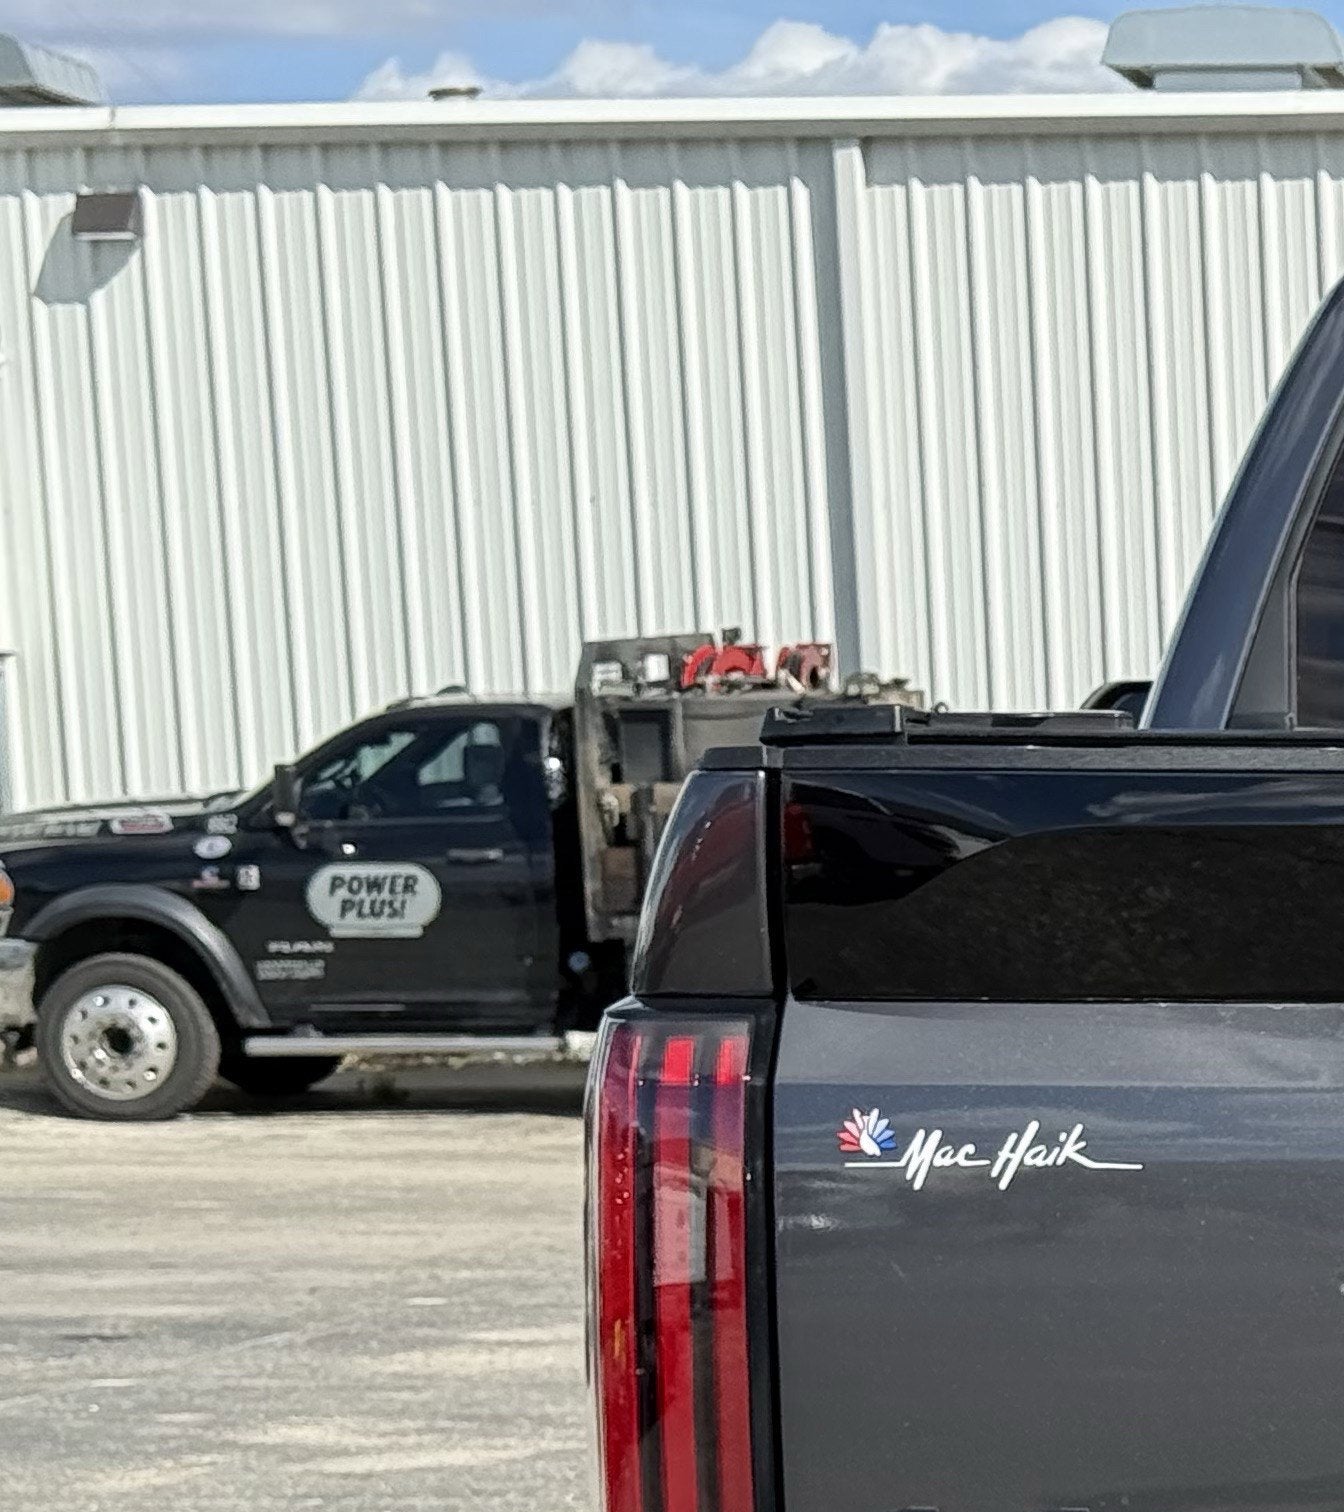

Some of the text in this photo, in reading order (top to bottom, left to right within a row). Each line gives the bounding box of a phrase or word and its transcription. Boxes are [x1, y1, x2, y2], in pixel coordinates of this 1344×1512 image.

[329, 874, 419, 897] POWER
[890, 1120, 1125, 1191] Mac Haik
